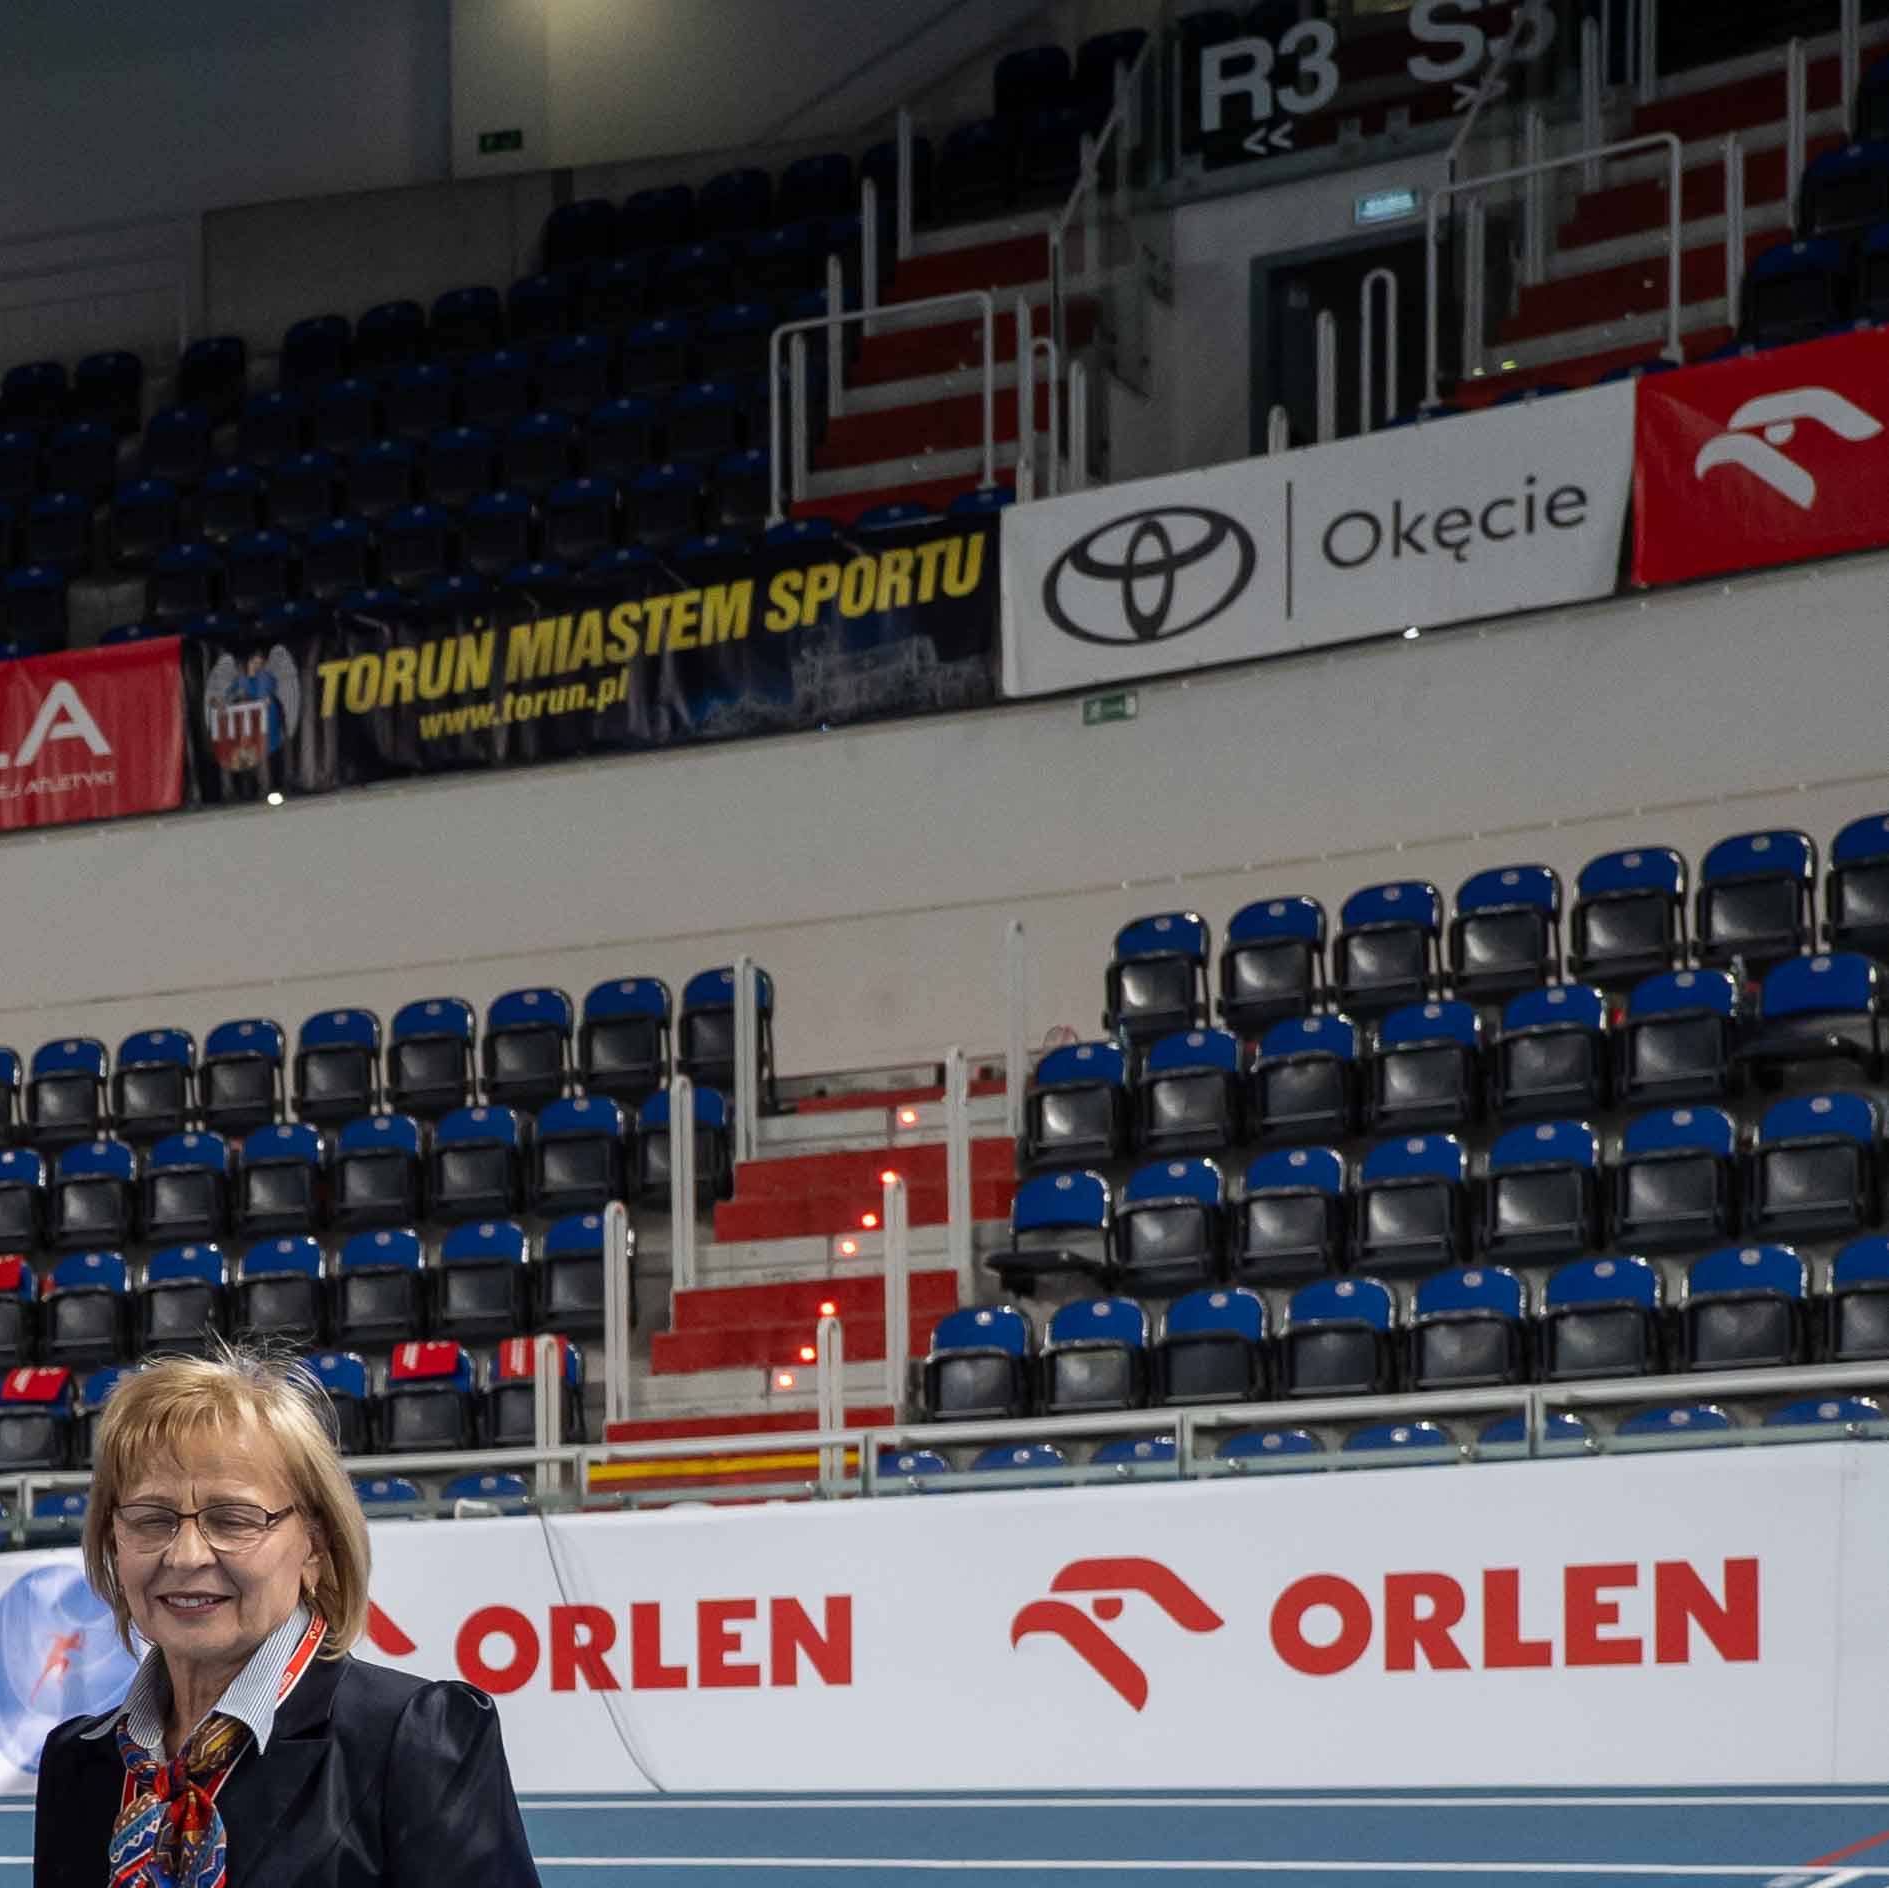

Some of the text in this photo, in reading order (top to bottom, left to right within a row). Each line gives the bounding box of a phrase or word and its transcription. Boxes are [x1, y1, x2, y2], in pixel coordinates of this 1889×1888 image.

[1200, 18, 1340, 132] R3
[1322, 475, 1589, 569] Okęcie
[317, 533, 986, 718] TORUŃ MIASTEM SPORTU
[420, 666, 629, 742] www.torun.pl
[456, 1595, 852, 1694] ORLEN
[1270, 1558, 1759, 1676] ORLEN
